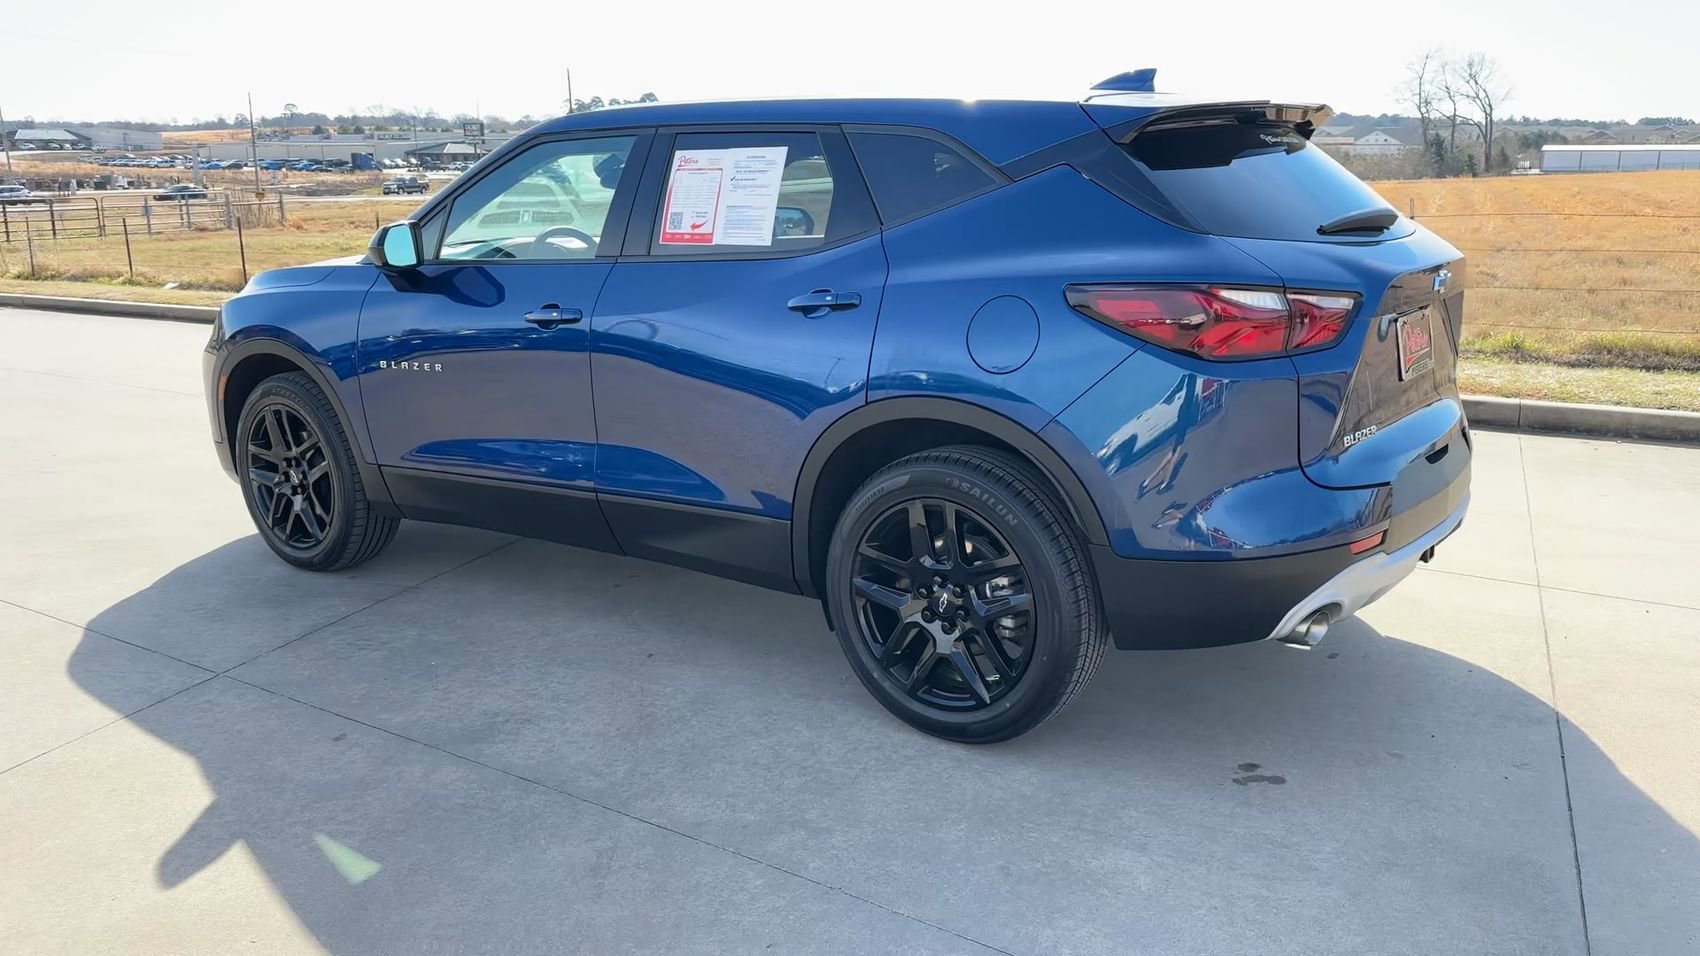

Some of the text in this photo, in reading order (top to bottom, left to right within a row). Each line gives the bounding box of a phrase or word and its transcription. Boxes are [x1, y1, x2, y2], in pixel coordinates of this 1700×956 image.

[380, 361, 442, 372] BLAZER
[1344, 426, 1377, 447] BLAZER
[960, 482, 1018, 526] SAILUN
